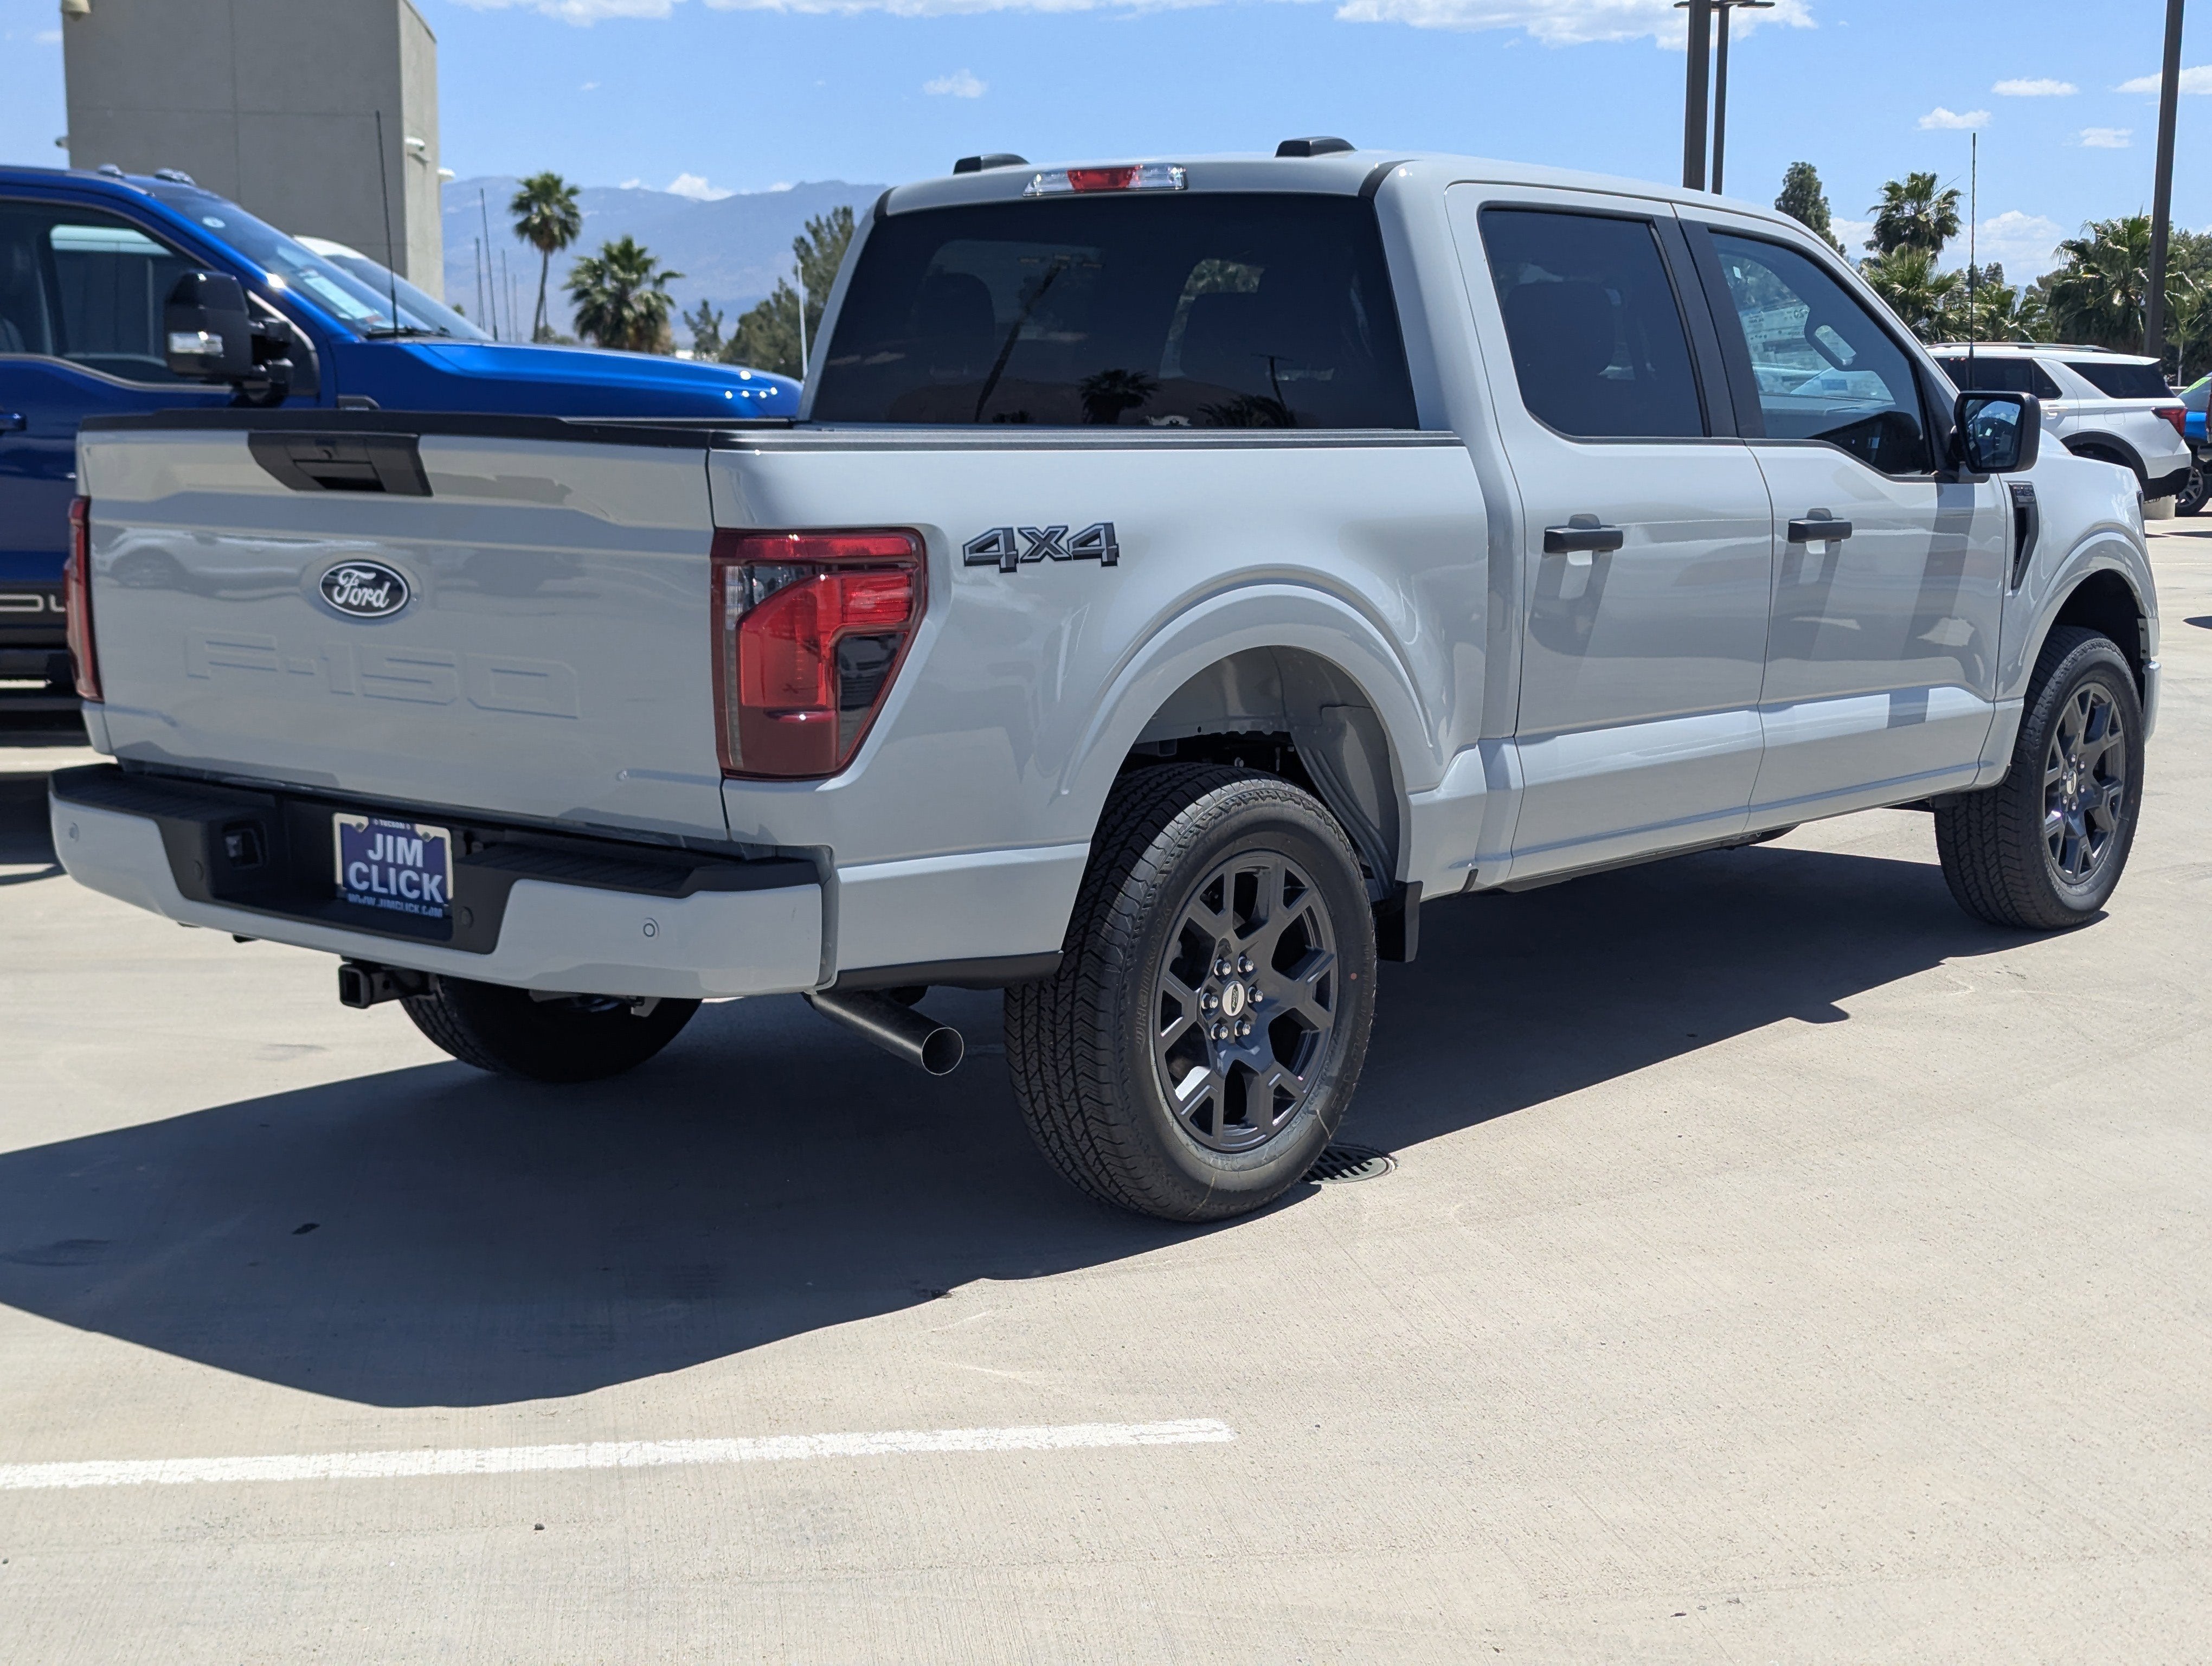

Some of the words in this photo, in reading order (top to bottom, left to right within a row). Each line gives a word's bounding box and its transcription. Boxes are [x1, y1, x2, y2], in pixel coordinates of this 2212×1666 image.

[333, 569, 391, 608] Ford
[185, 626, 581, 720] F-150
[367, 833, 423, 868] JIM
[349, 862, 443, 903] CLICK
